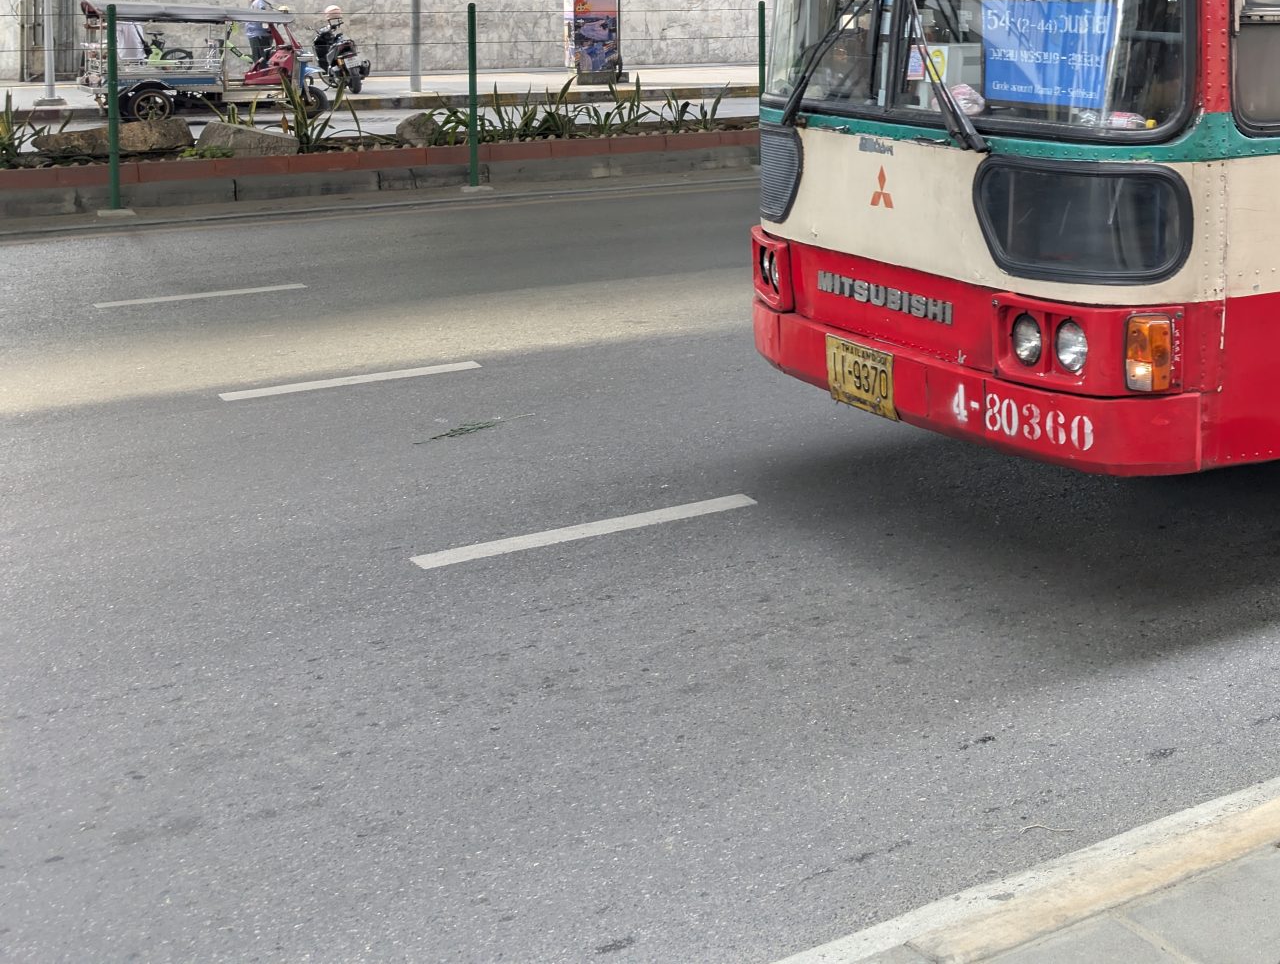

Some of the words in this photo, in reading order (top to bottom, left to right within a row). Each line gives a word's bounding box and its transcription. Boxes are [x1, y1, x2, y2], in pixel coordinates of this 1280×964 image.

[987, 10, 1011, 30] 54
[1017, 18, 1058, 34] (2-44)
[817, 270, 953, 325] MITSUBISHI
[833, 352, 888, 399] 11-9370
[952, 384, 1095, 451] 4-80360
